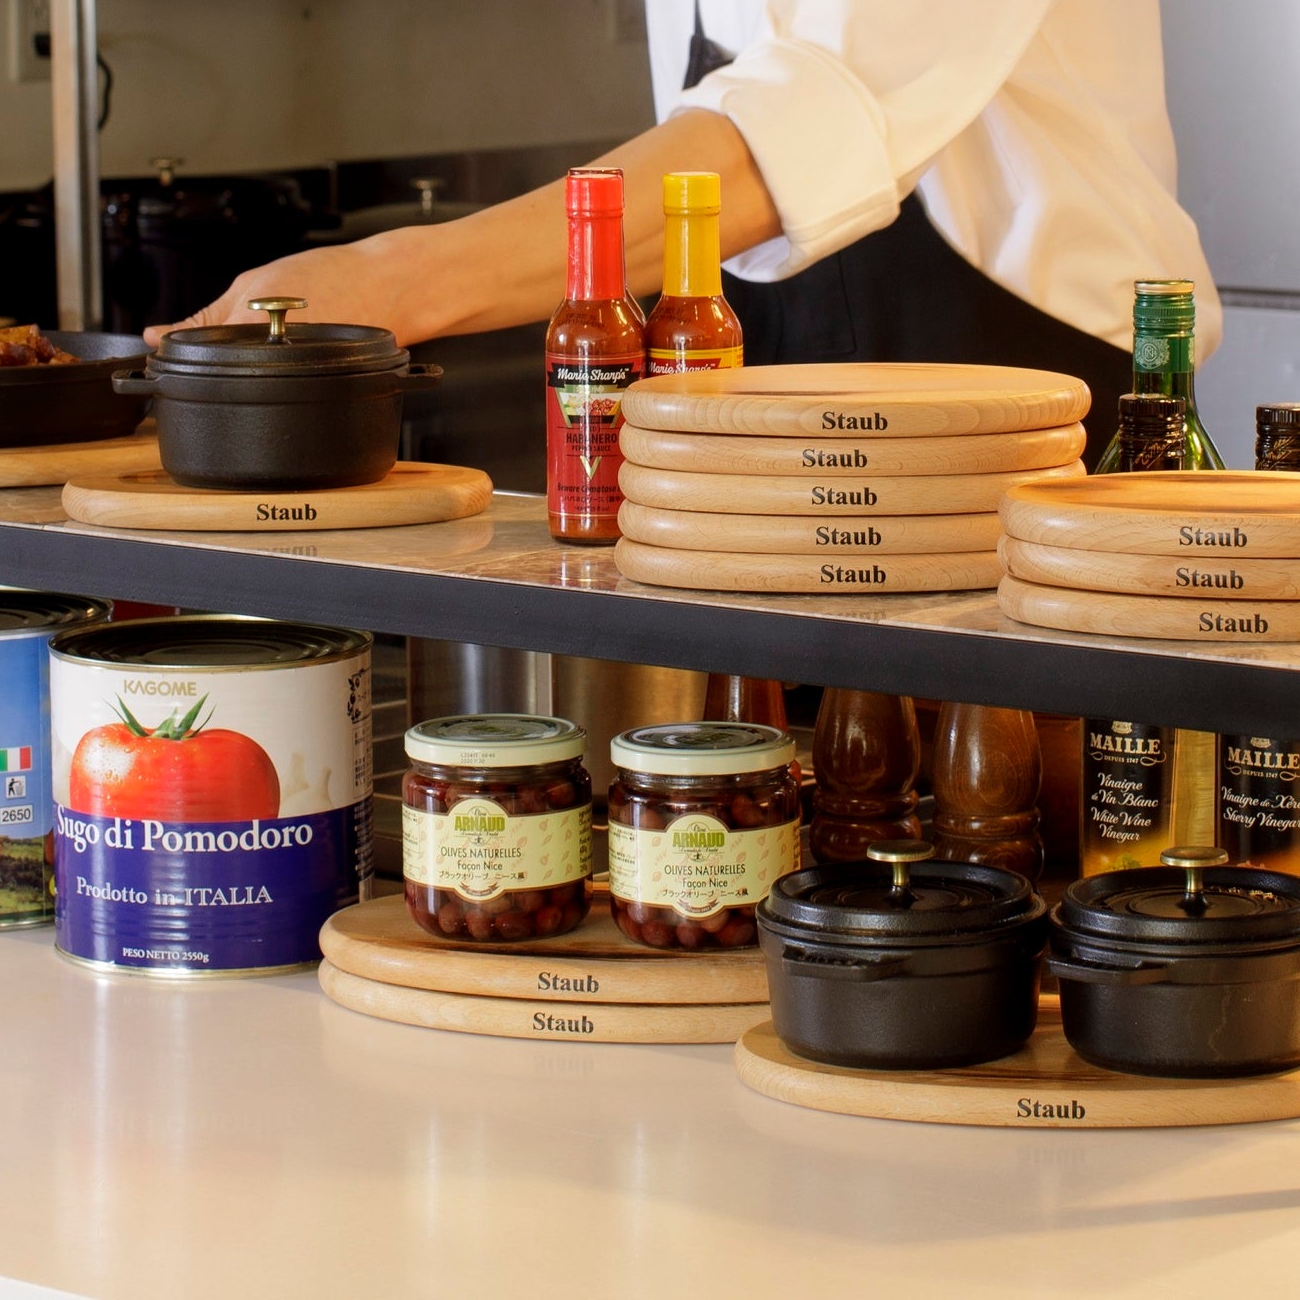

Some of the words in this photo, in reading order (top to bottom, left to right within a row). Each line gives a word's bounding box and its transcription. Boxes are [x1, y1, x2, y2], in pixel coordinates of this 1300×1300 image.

[557, 367, 590, 381] Marie
[590, 367, 626, 384] Sharp's
[821, 411, 888, 431] Staub
[802, 449, 868, 468] Staub
[811, 486, 878, 506] Staub
[256, 503, 317, 521] Staub
[815, 526, 882, 546] Staub
[1179, 526, 1248, 548] Staub
[820, 564, 886, 584] Staub
[1175, 567, 1244, 589] Staub
[1199, 611, 1269, 634] Staub
[123, 679, 197, 697] KAGOME
[1090, 732, 1160, 755] MAILLE
[1103, 754, 1125, 763] DEPUIS
[1227, 746, 1300, 770] MAILLE
[1097, 772, 1143, 793] Vinaigre
[1242, 768, 1264, 777] DEPUIS
[1098, 789, 1117, 805] Vin
[1118, 791, 1159, 808] Blanc
[1221, 786, 1259, 806] Vinaigre
[1259, 798, 1270, 808] de
[1, 808, 32, 823] 2650
[454, 816, 506, 832] ARNAUD
[1091, 807, 1119, 824] White
[1118, 811, 1152, 827] Wine
[1223, 807, 1256, 828] Sherry
[56, 804, 100, 853] Sugo
[104, 818, 134, 849] di
[141, 819, 313, 853] Pomodoro
[1098, 824, 1141, 843] Vinegar
[672, 832, 725, 848] ARNAUD
[440, 847, 467, 858] OLIVES
[469, 848, 522, 859] NATURELLES
[457, 860, 481, 872] Façon
[483, 861, 503, 871] Nice
[664, 864, 692, 876] OLIVES
[695, 863, 746, 876] NATURELLES
[76, 876, 148, 906] Prodotto
[154, 888, 178, 906] in
[184, 885, 273, 907] ITALIA
[682, 878, 707, 890] Façon
[709, 878, 728, 888] Nice
[122, 947, 146, 958] PESO
[146, 949, 181, 961] NETTO
[181, 951, 210, 964] 2550g
[538, 971, 599, 993] Staub
[533, 1011, 594, 1034] Staub
[1017, 1097, 1086, 1120] Staub
